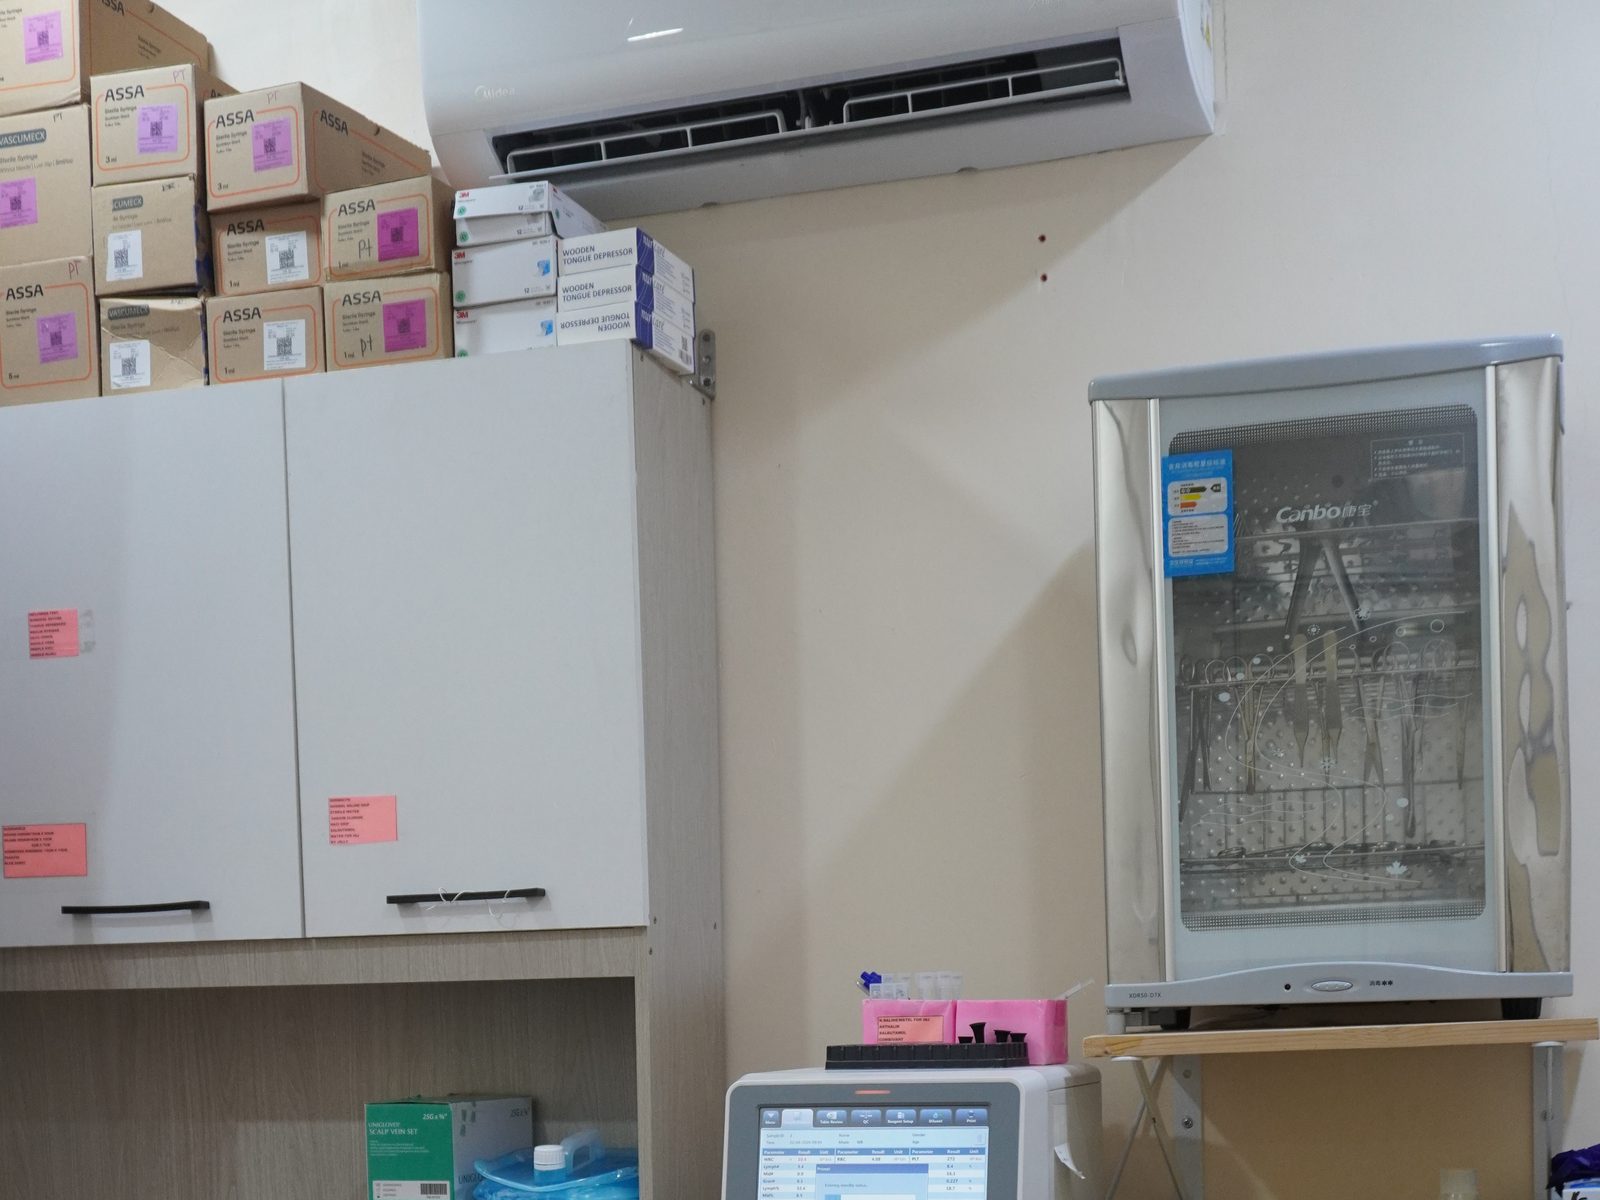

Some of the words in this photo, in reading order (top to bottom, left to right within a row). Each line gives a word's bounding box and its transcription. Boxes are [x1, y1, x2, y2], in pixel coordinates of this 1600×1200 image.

[104, 85, 144, 102] ASSA
[216, 109, 254, 128] ASSA
[320, 110, 348, 136] ASSA
[338, 199, 375, 216] ASSA
[227, 219, 264, 236] ASSA
[562, 245, 595, 256] WOODEN
[563, 255, 592, 265] TONGUE
[594, 248, 633, 260] DEPRESSOR
[68, 260, 81, 278] PT
[6, 284, 44, 300] ASSA
[562, 282, 594, 294] WOODEN
[563, 292, 591, 302] TONGUE
[593, 285, 632, 297] DEPRESSOR
[342, 290, 382, 307] ASSA
[223, 307, 261, 323] ASSA
[561, 317, 599, 328] DEPRESSOR
[602, 312, 629, 322] TONGUE
[598, 321, 630, 332] WOODEN
[1276, 504, 1340, 523] Canbo
